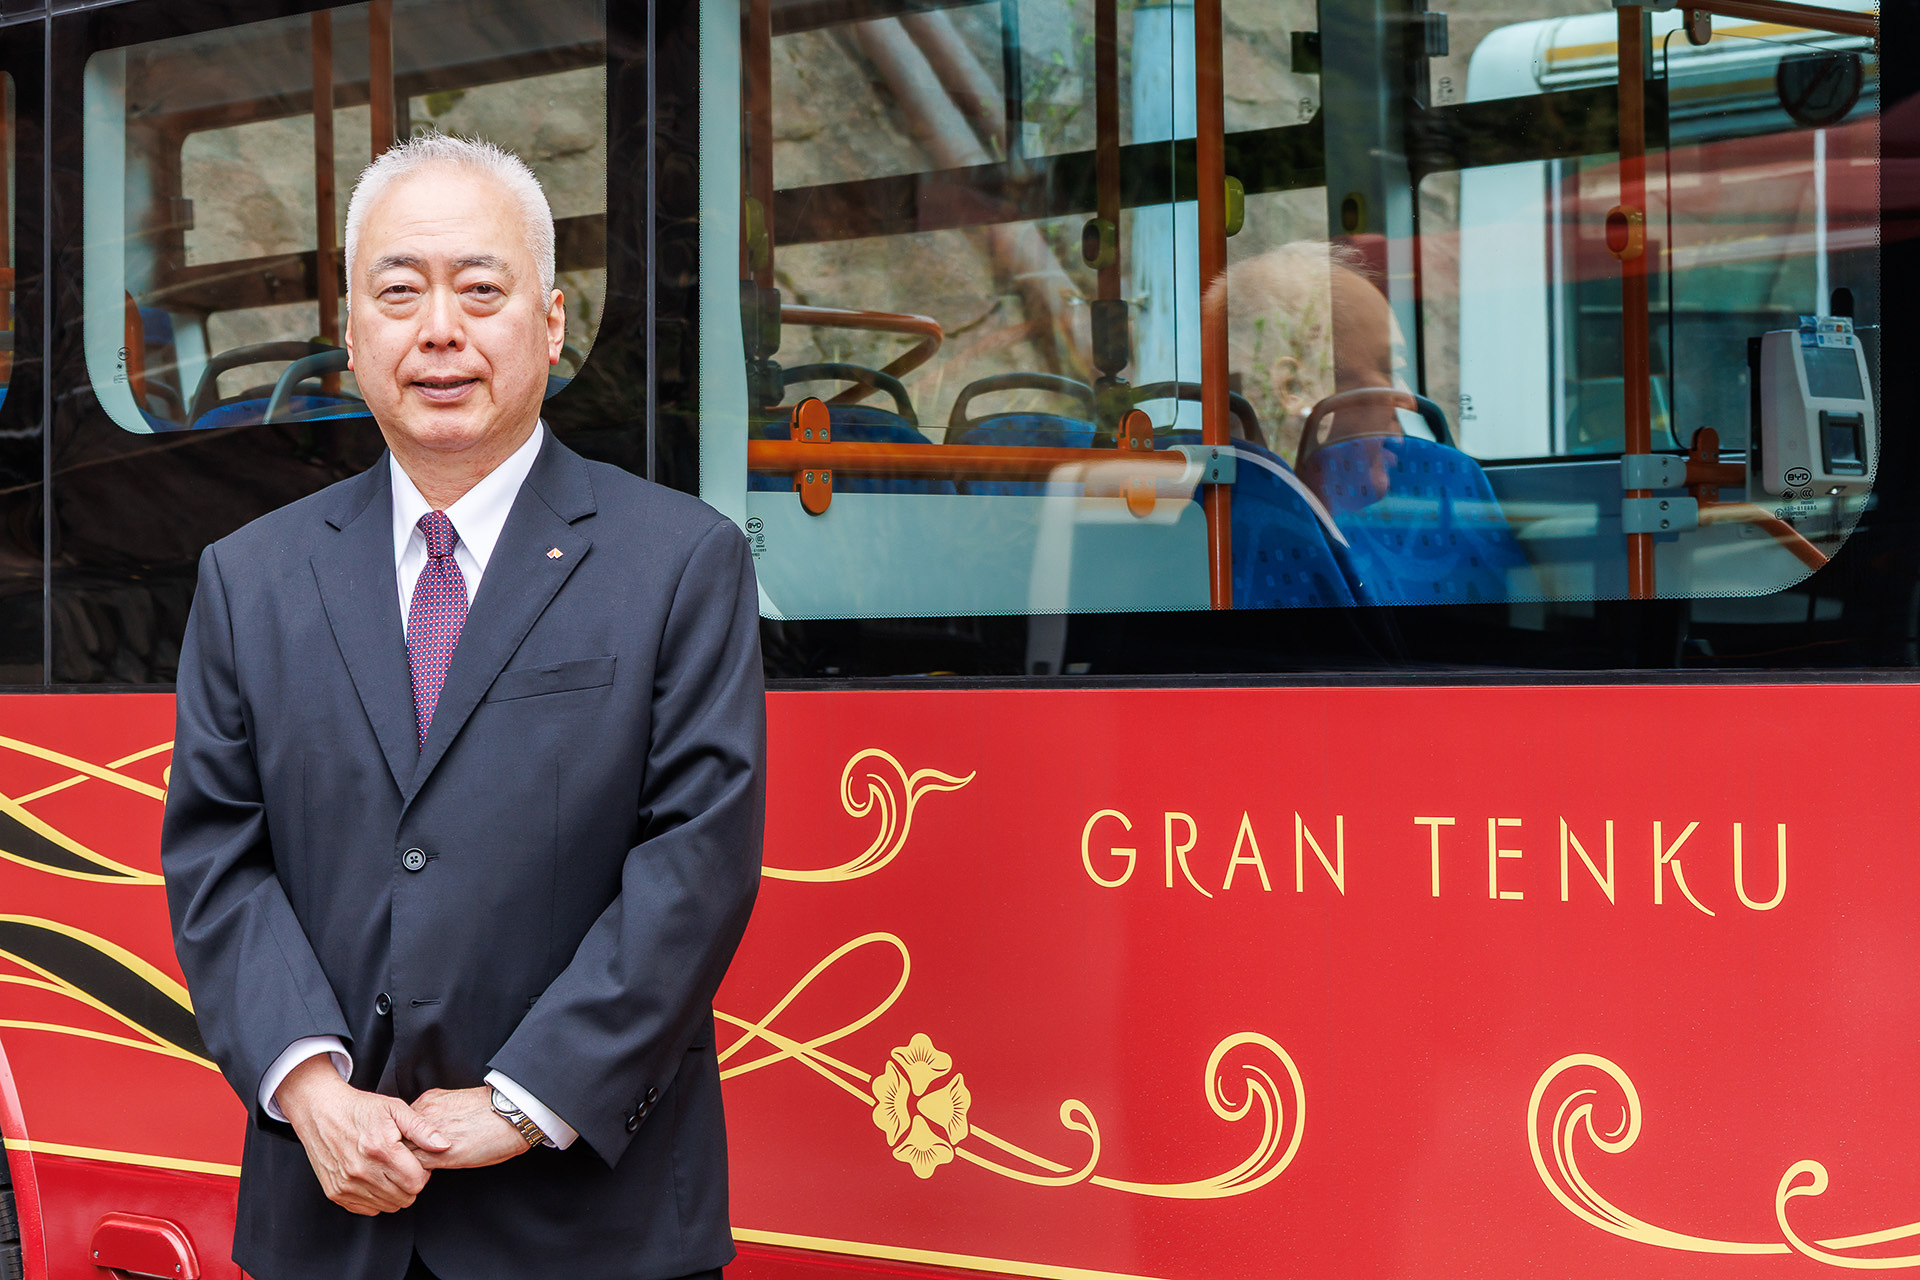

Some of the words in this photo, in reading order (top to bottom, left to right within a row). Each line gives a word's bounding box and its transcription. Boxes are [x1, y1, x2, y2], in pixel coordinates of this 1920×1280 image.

[1788, 473, 1809, 481] BYD
[1081, 809, 1345, 899] GRAN
[1414, 815, 1787, 917] TENKU
